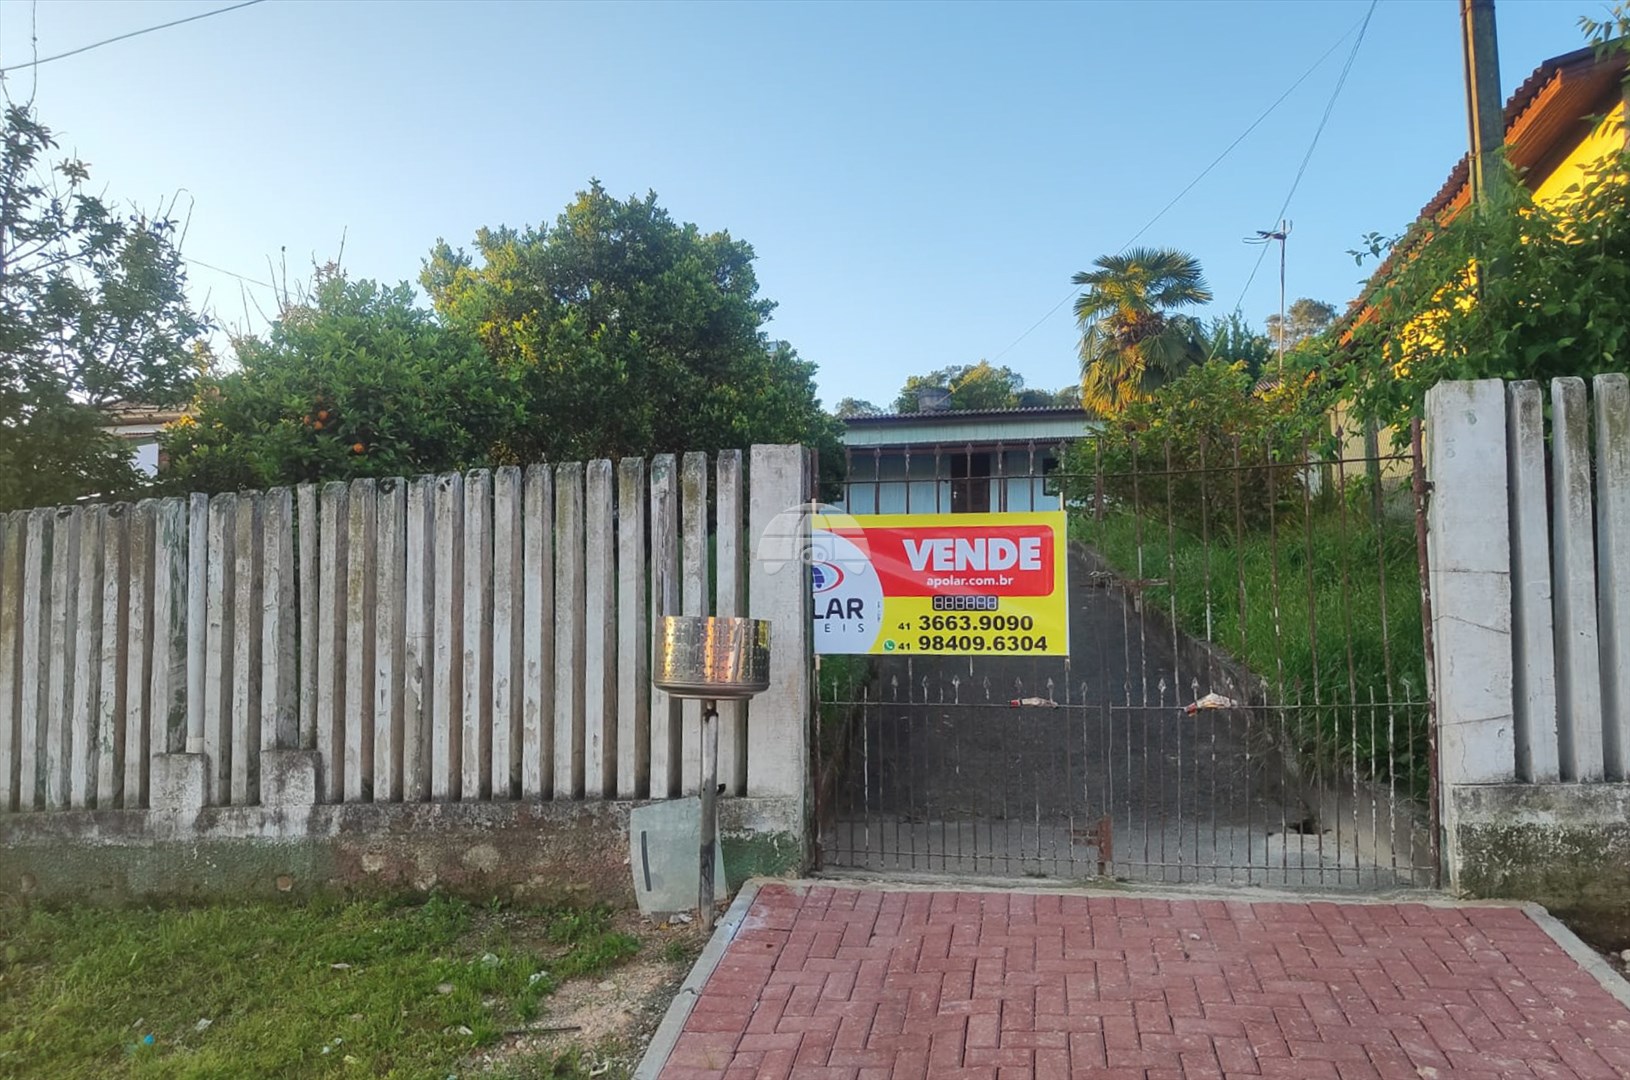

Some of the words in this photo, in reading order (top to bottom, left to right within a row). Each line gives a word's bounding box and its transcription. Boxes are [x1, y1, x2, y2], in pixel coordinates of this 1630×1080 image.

[902, 536, 1042, 572] VENDE
[926, 575, 1014, 588] apolar.com.br
[812, 597, 864, 619] LAR
[898, 622, 911, 631] 41
[918, 615, 1033, 631] 3663.9090
[898, 642, 911, 650] 41
[918, 635, 1048, 651] 98409.6304
